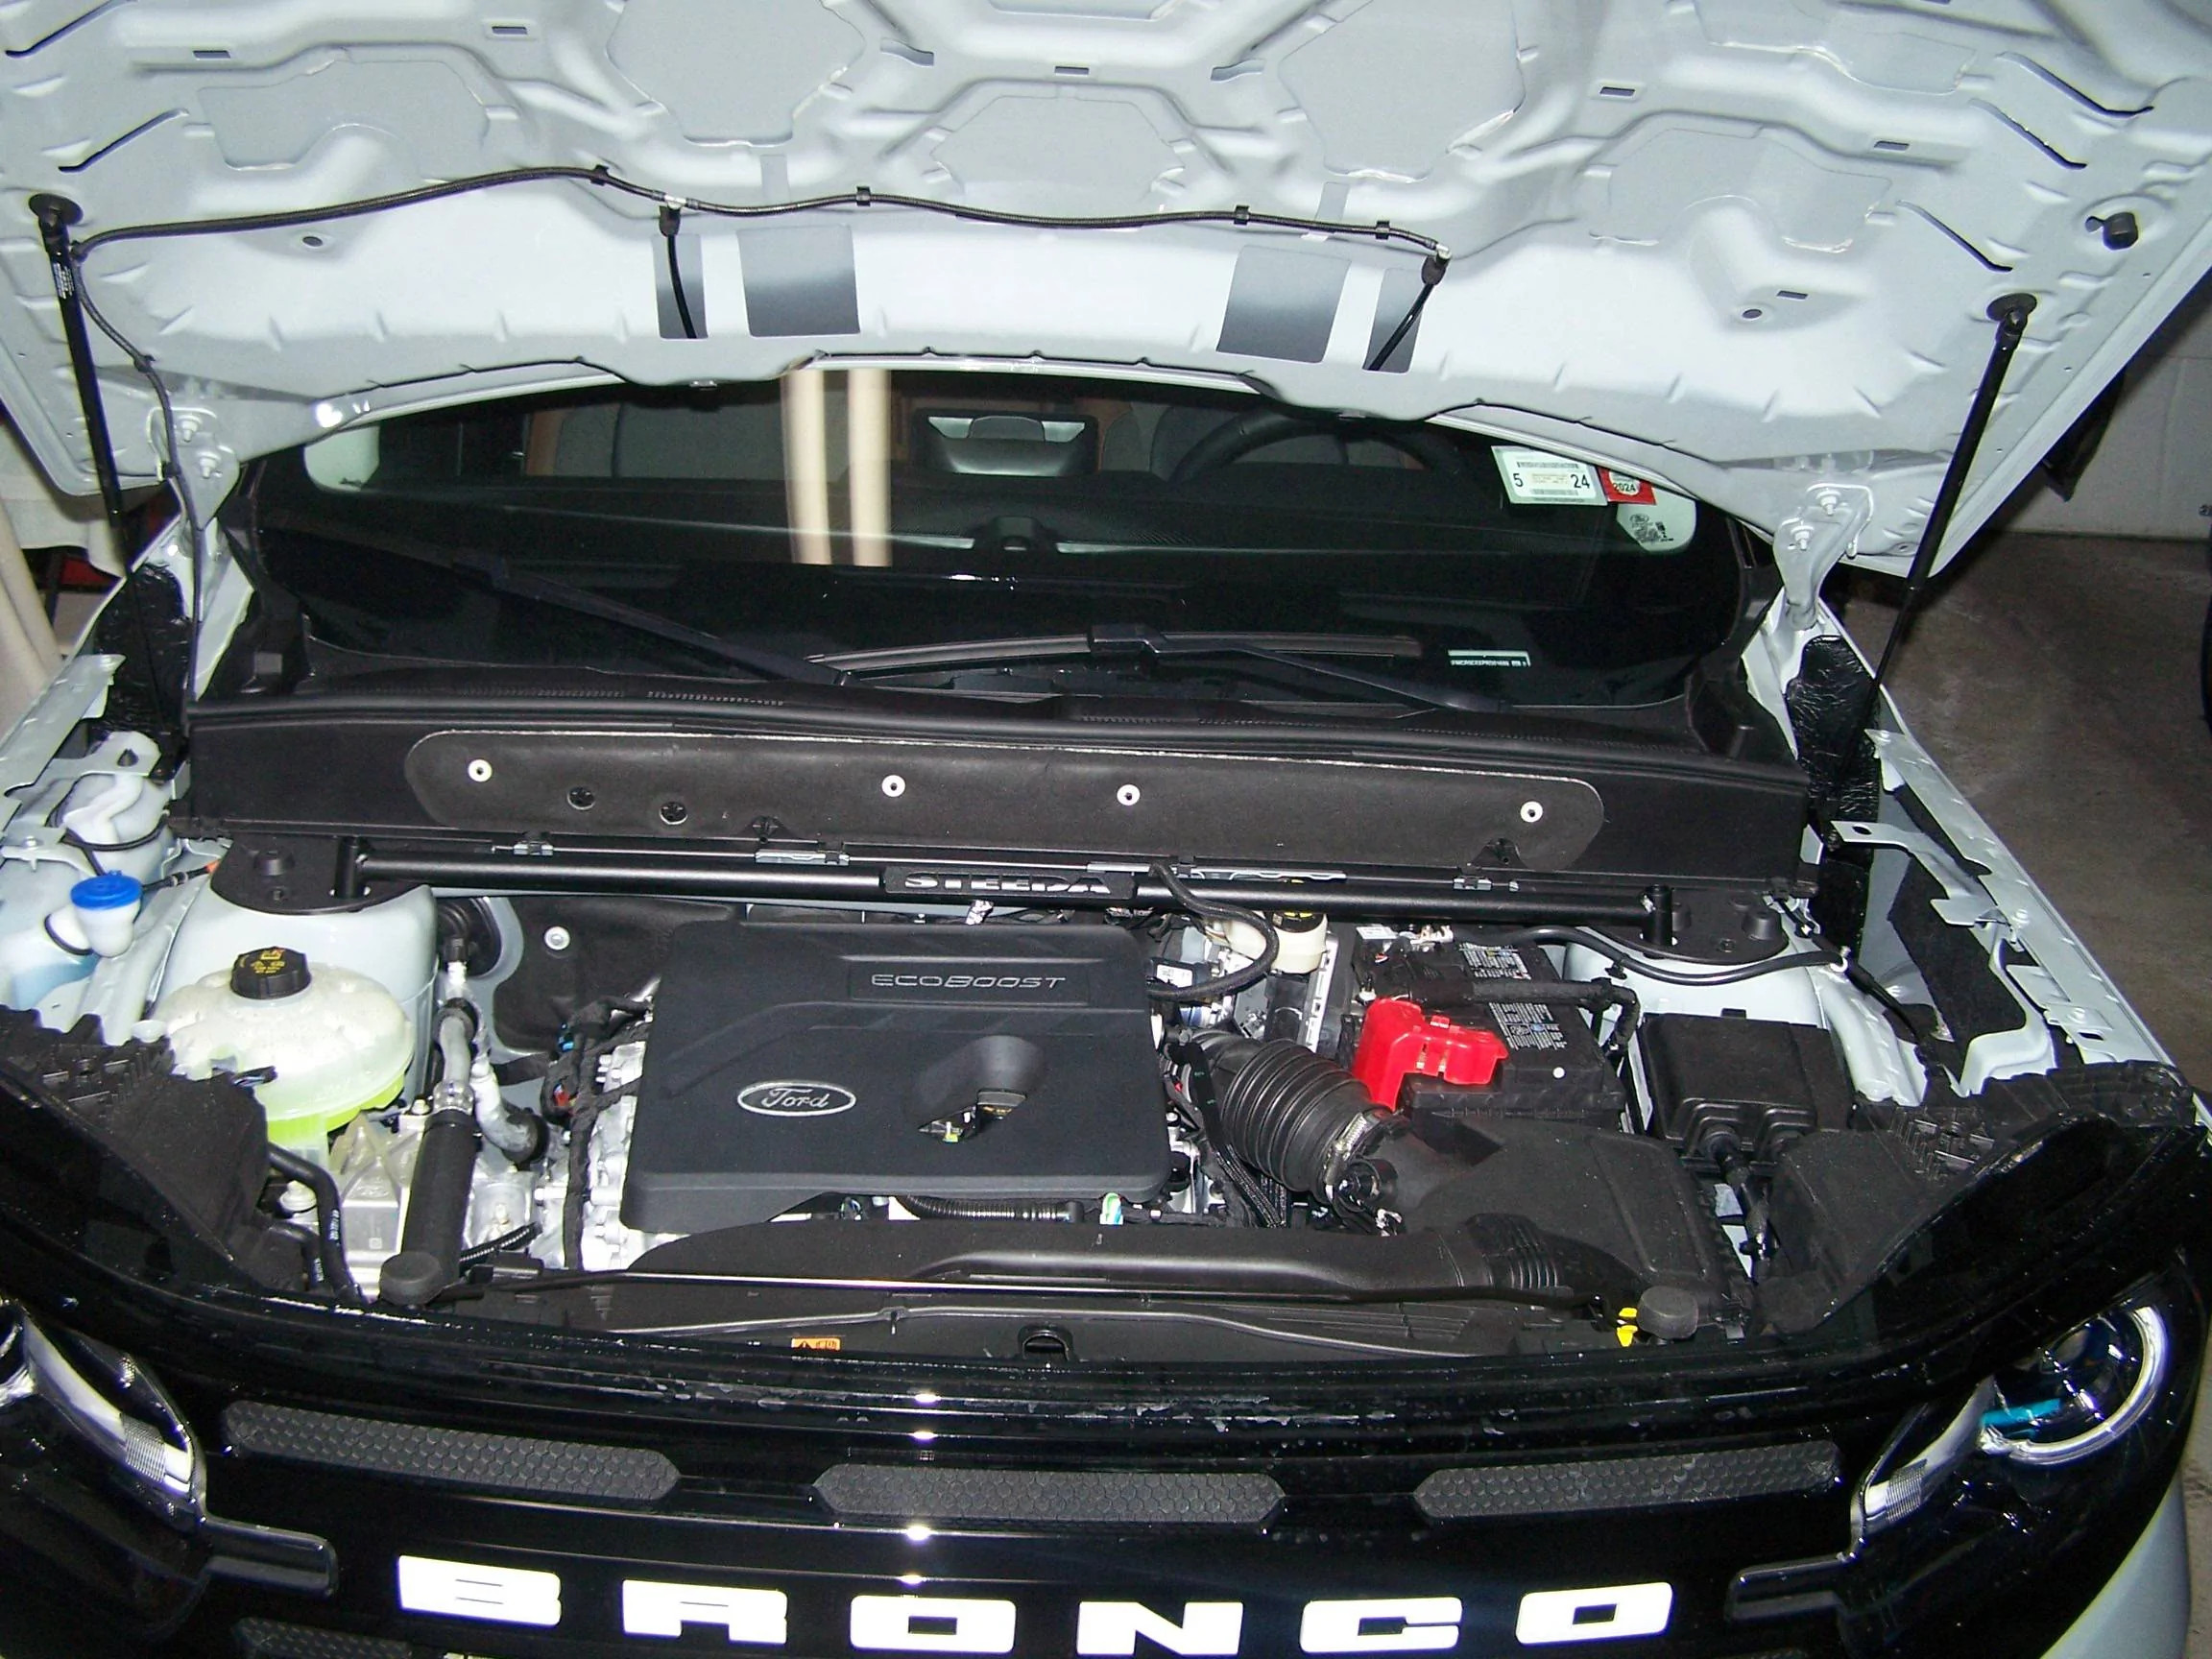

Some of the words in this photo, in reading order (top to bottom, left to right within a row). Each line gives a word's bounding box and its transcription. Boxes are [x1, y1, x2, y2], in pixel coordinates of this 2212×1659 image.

[1512, 472, 1524, 488] 5
[1570, 473, 1590, 489] 24
[904, 871, 1110, 894] STEEDA
[871, 974, 1067, 989] ECOBOOST
[760, 1088, 830, 1110] Ford
[397, 1554, 1673, 1656] BRONCO
